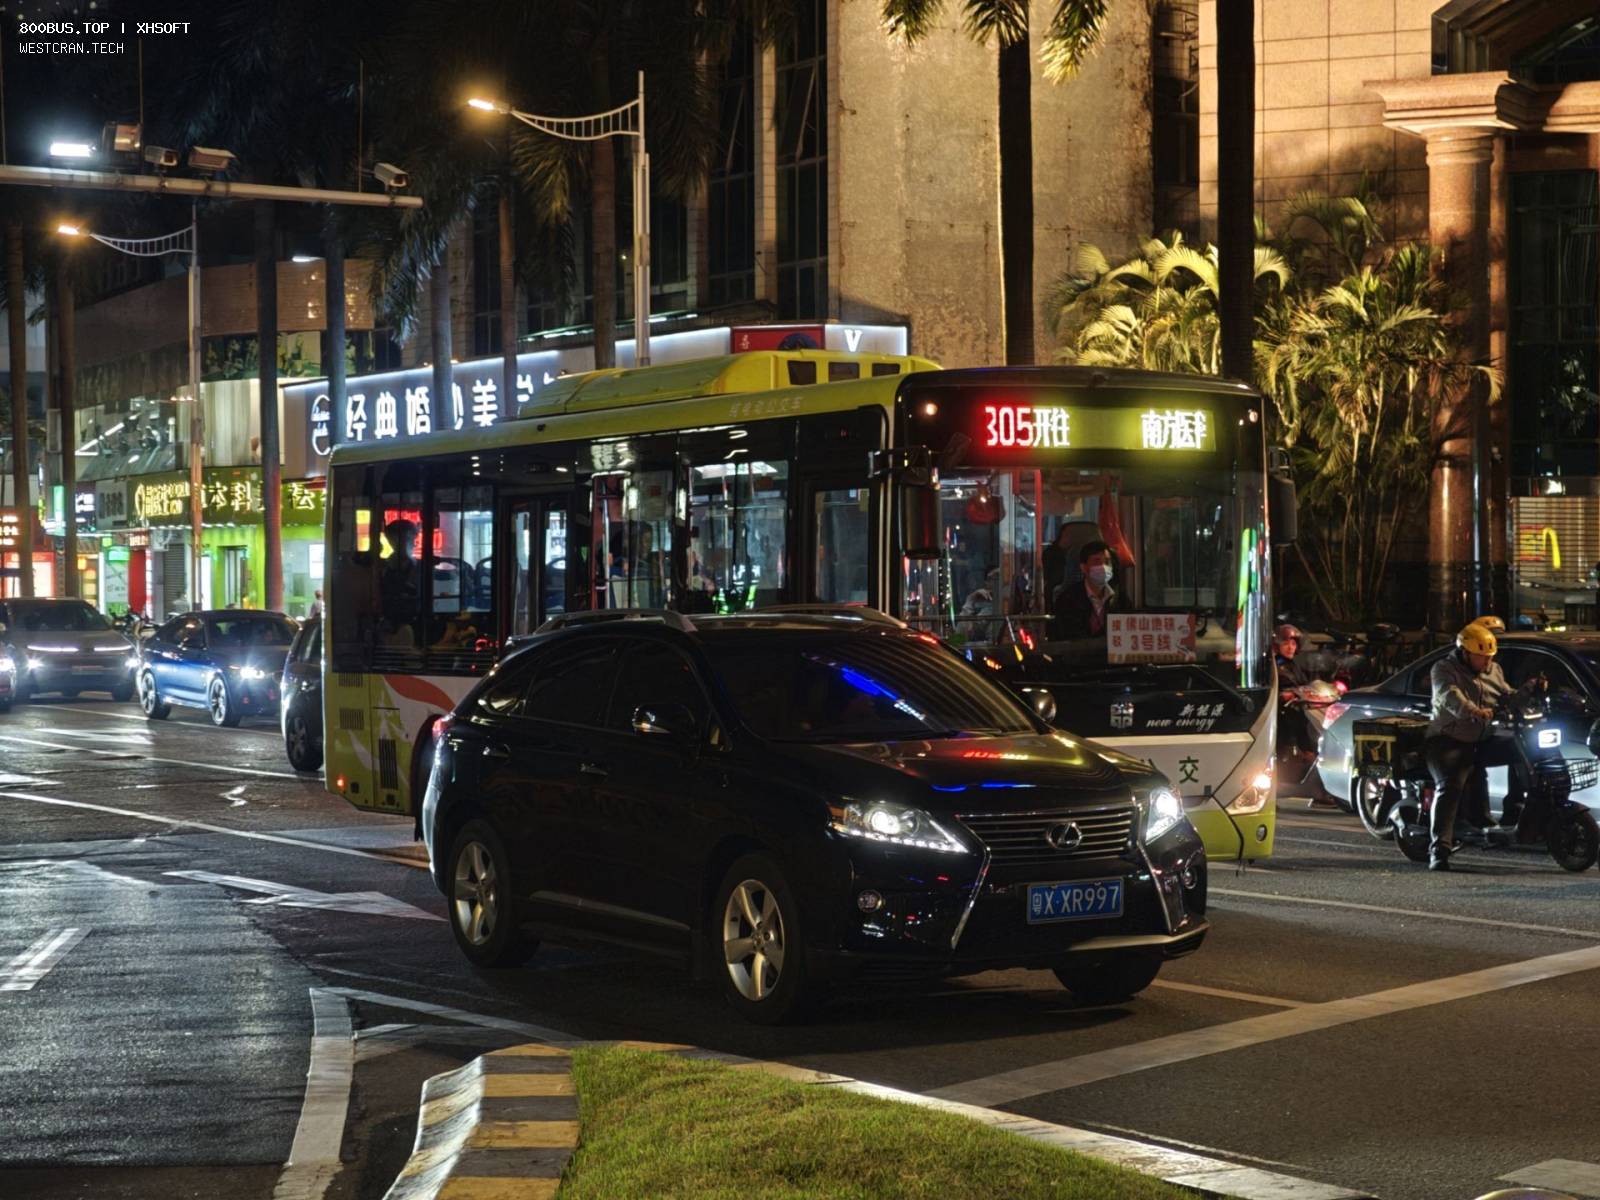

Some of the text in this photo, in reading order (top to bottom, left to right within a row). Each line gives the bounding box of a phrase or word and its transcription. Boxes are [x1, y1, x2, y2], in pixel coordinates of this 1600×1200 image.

[1130, 634, 1170, 650] 3号线
[1179, 703, 1225, 717] 新能源
[1145, 718, 1216, 731] new energy
